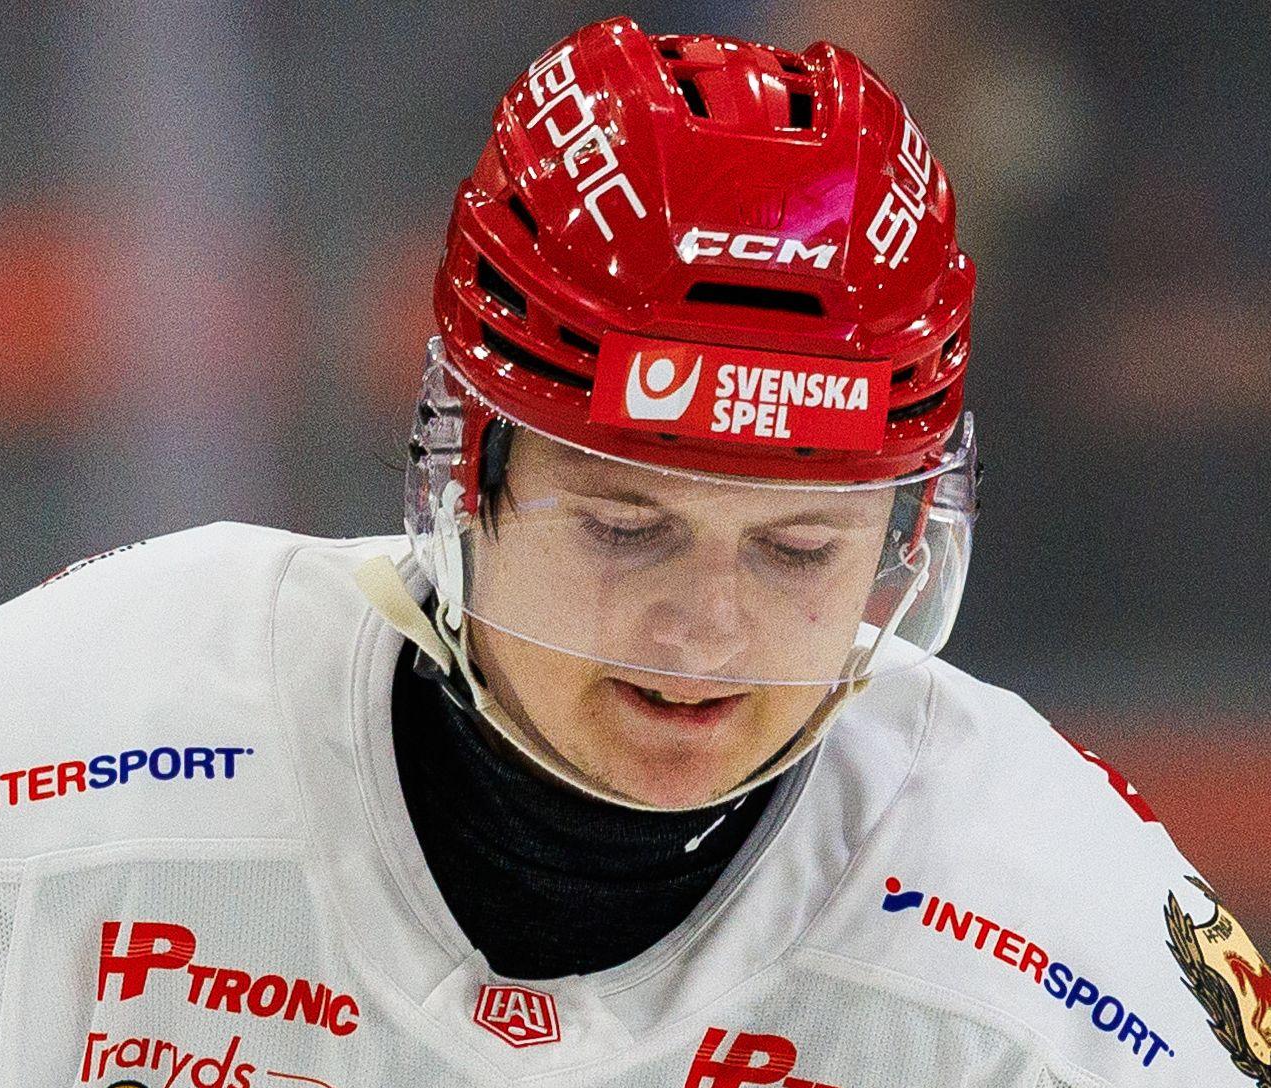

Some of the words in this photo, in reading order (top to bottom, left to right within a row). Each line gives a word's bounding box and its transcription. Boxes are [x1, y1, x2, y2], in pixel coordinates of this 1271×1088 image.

[677, 228, 839, 270] CCM
[714, 363, 869, 411] SVENSKA
[710, 398, 791, 439] SPEL
[187, 965, 360, 1036] TRONIC
[922, 896, 1176, 1067] INTERSPORT
